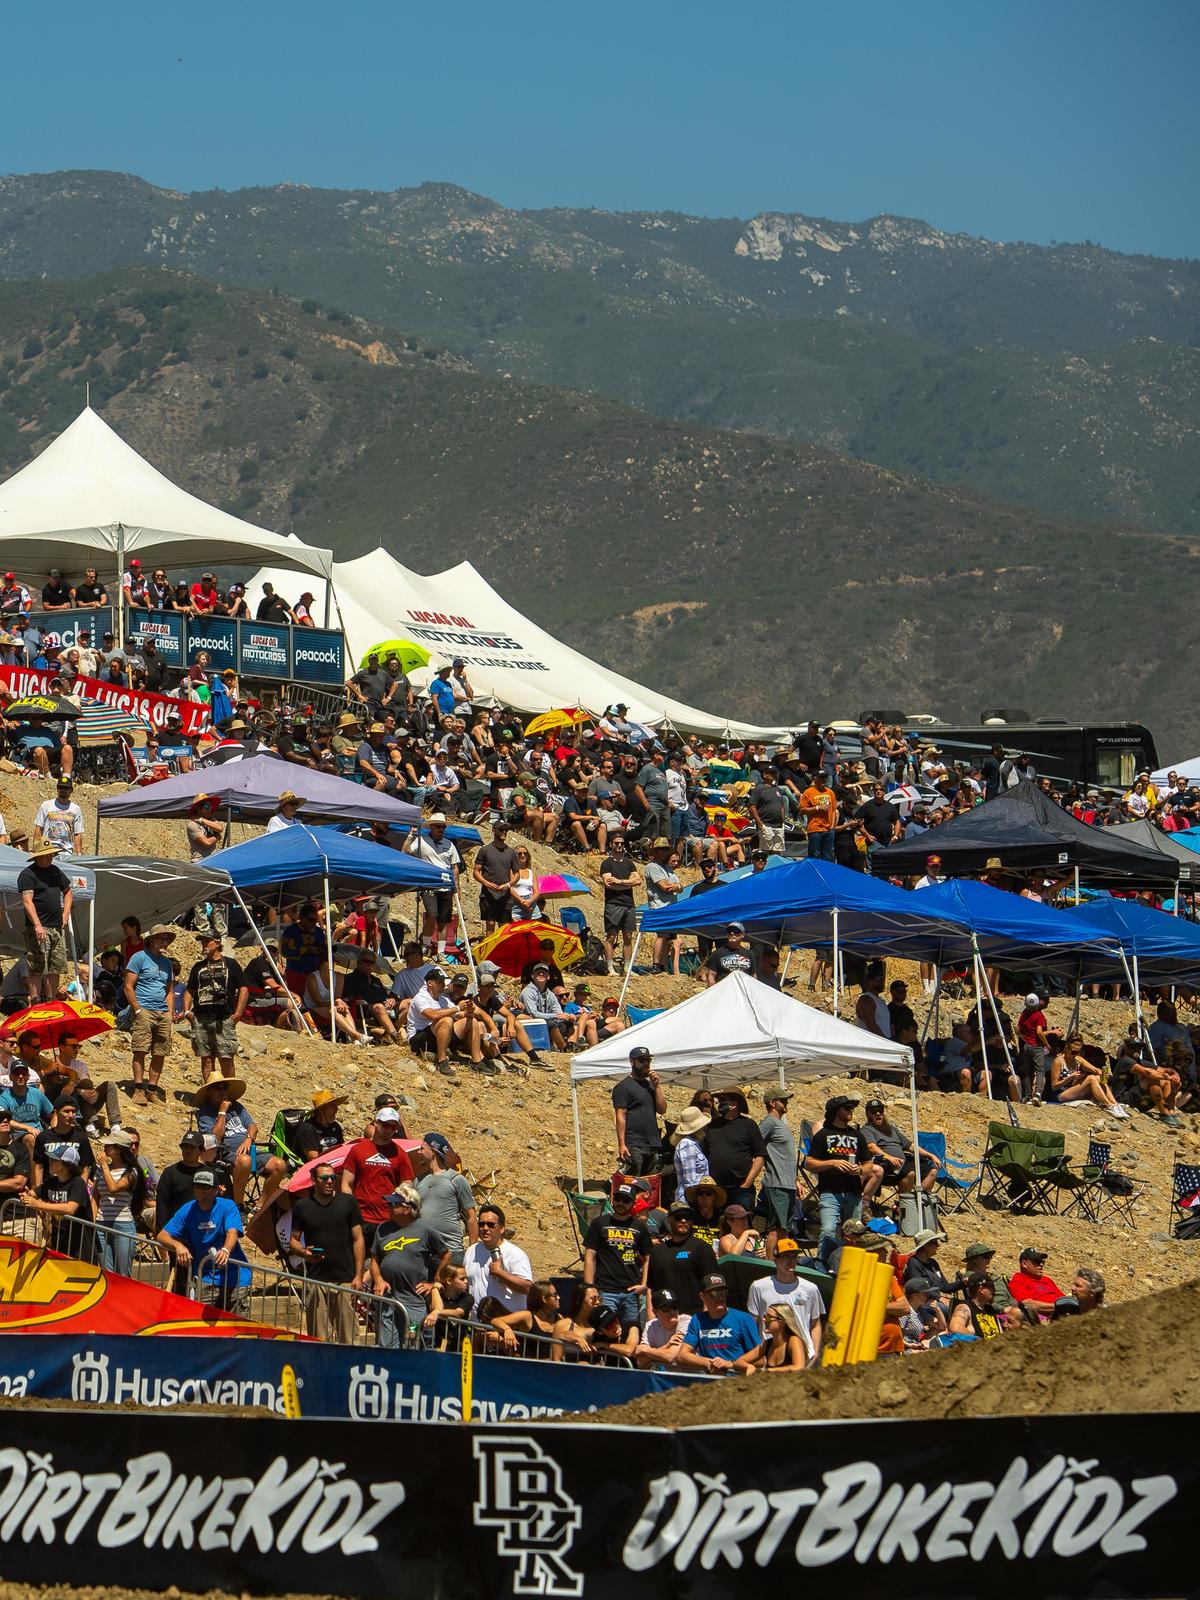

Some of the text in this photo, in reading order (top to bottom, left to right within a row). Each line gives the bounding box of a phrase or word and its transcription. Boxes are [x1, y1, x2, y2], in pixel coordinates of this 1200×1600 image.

[406, 610, 476, 629] LUCAS OIL
[141, 624, 169, 634] LUCAS OIL
[133, 636, 179, 649] MOCROSS
[188, 635, 229, 652] peacock
[252, 636, 278, 647] LUCAS OIL
[404, 626, 523, 649] MOTOCROSS
[242, 649, 286, 662] MOTOCROSS
[295, 648, 336, 665] peacock
[473, 658, 513, 669] CLASS
[511, 660, 550, 671] ZONE
[826, 1135, 858, 1149] FXR
[607, 1229, 635, 1240] BAJA
